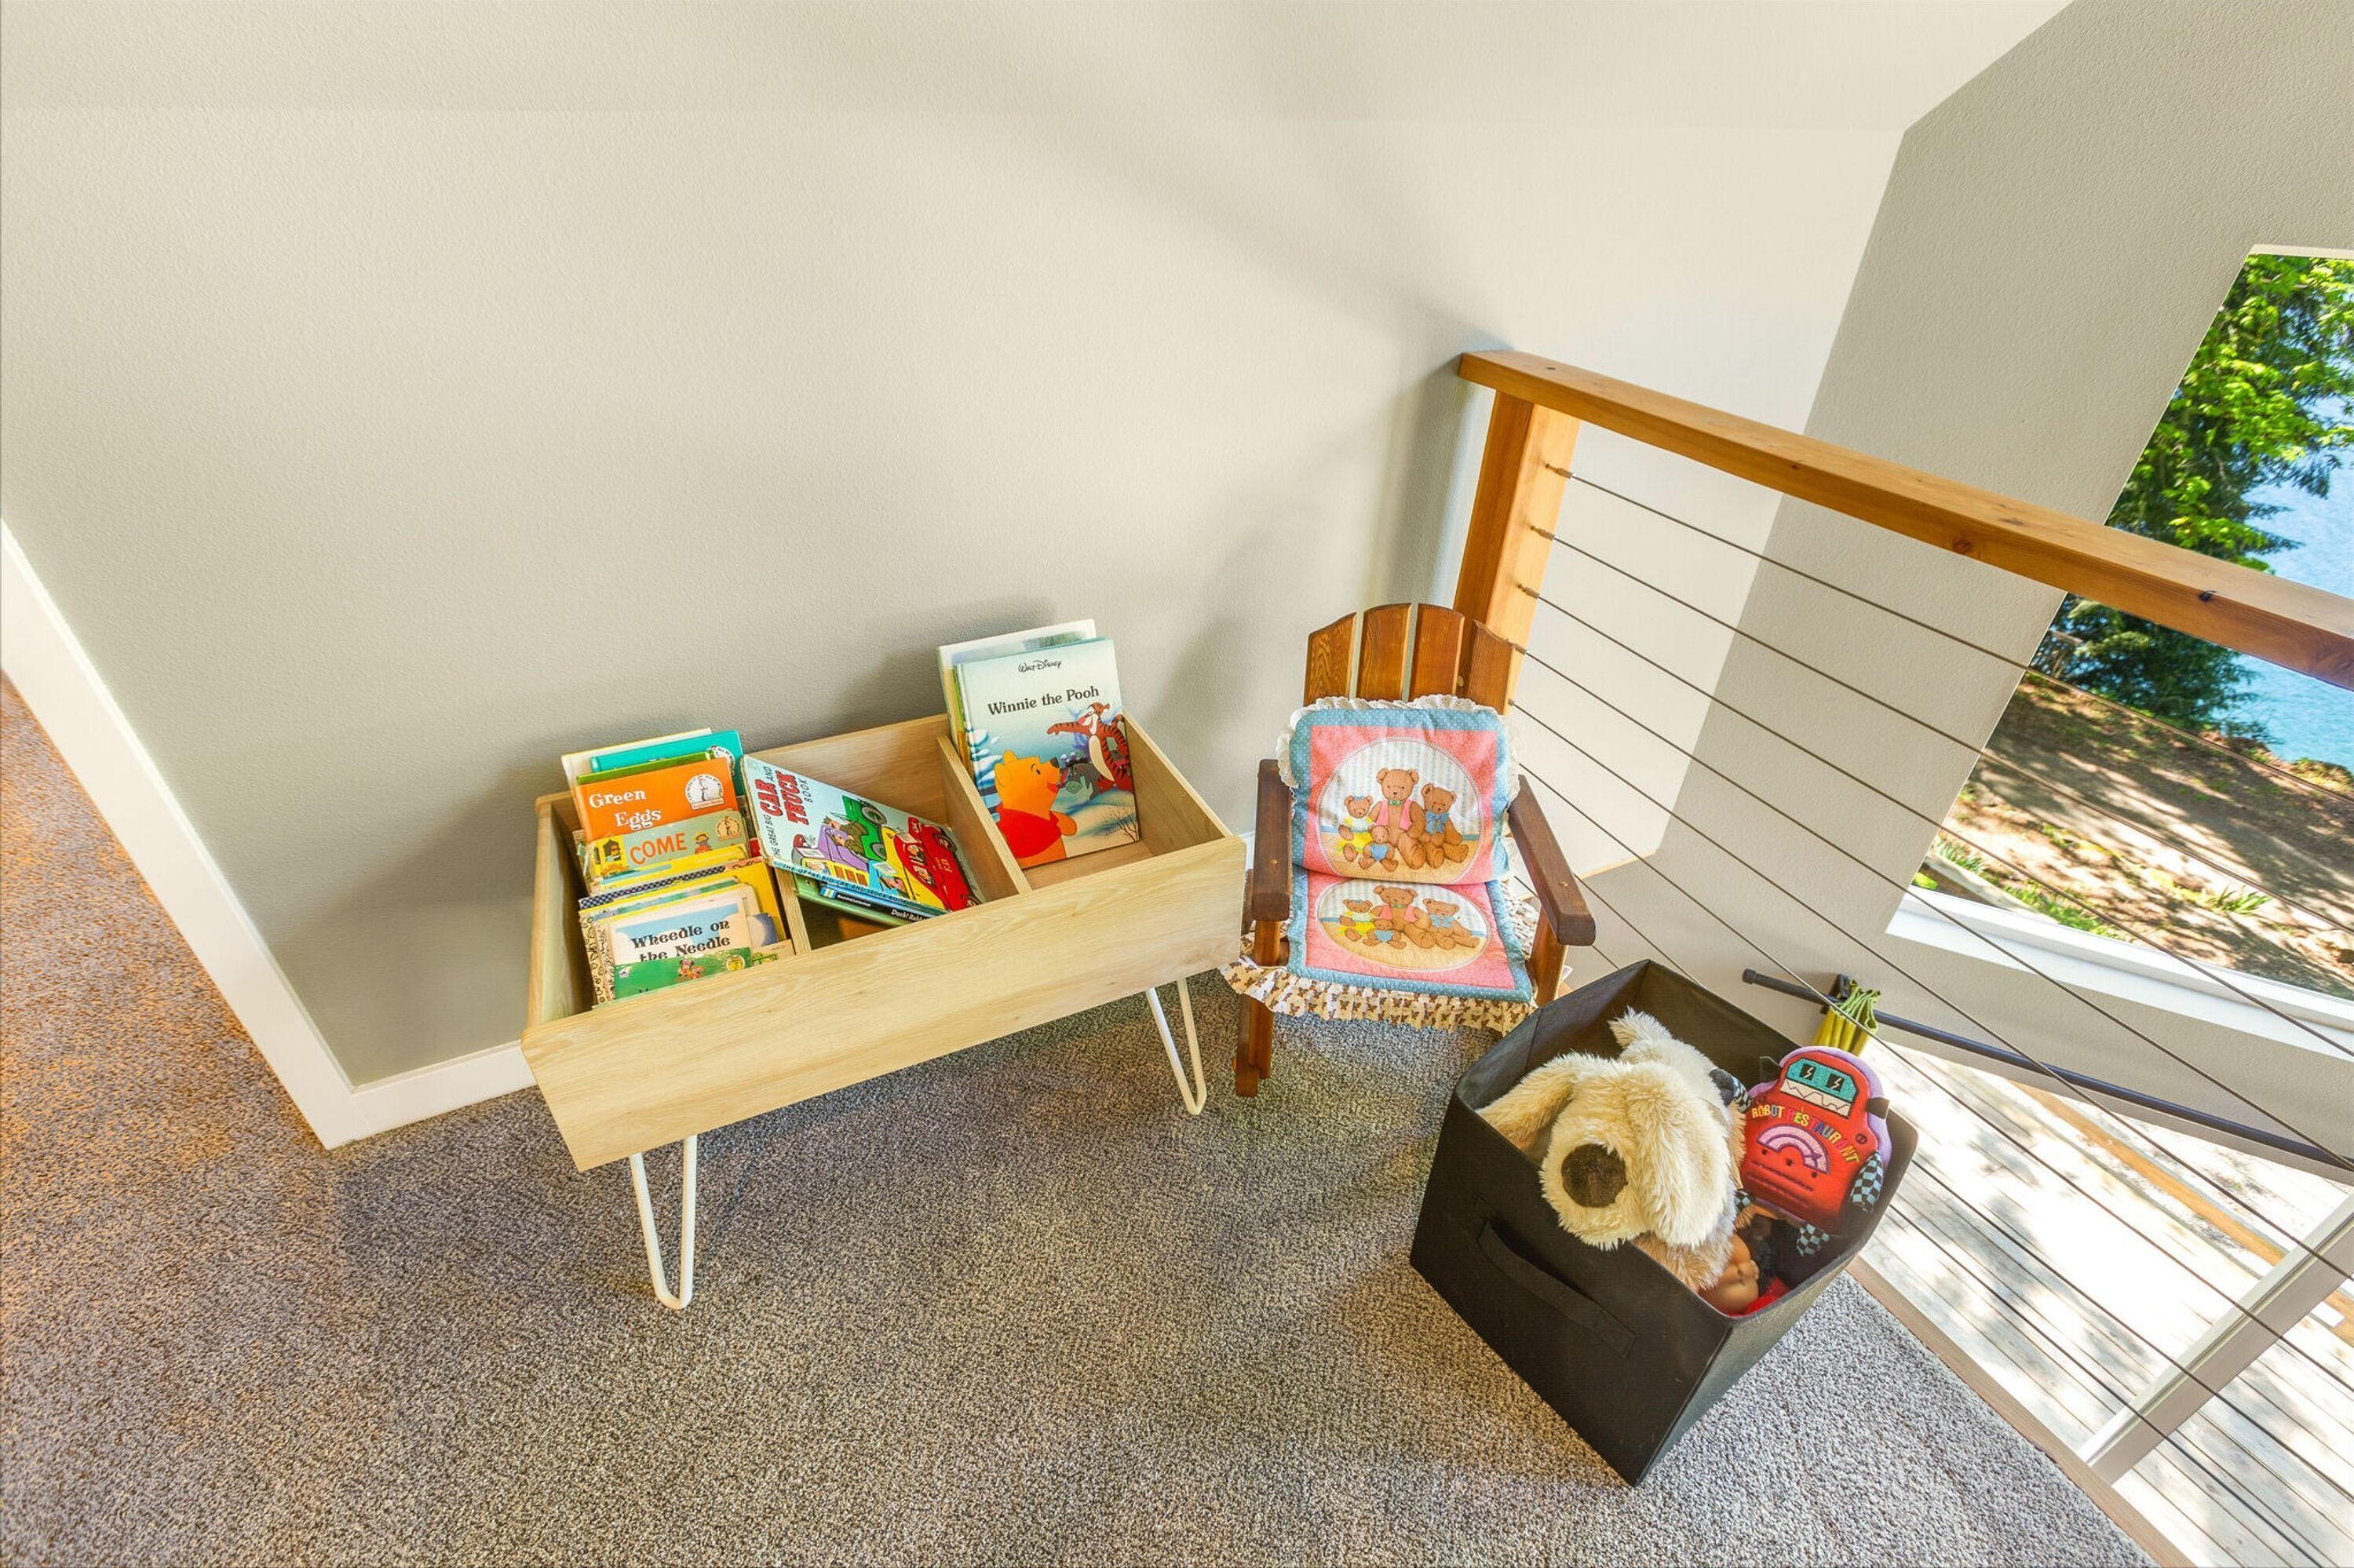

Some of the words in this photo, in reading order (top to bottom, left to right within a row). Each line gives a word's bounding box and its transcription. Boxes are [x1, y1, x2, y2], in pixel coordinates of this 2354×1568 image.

[1032, 659, 1062, 670] Disney
[987, 698, 1037, 716] Winnie
[1041, 694, 1064, 706] the
[1066, 685, 1100, 702] Pooh
[763, 765, 775, 782] AND
[589, 789, 646, 809] Green
[754, 779, 783, 816] CAR
[775, 770, 809, 826] TRUCK
[798, 778, 813, 804] BOOK
[614, 808, 662, 831] Eggs
[763, 814, 774, 826] BIG
[765, 825, 779, 846] GREAT
[630, 833, 688, 865] COME
[631, 925, 703, 949] Wheedle
[710, 920, 731, 932] on
[639, 951, 668, 962] the
[675, 936, 731, 957] Needle
[1751, 1104, 1786, 1118] ROBOT
[1786, 1107, 1860, 1163] RESTAURANT
